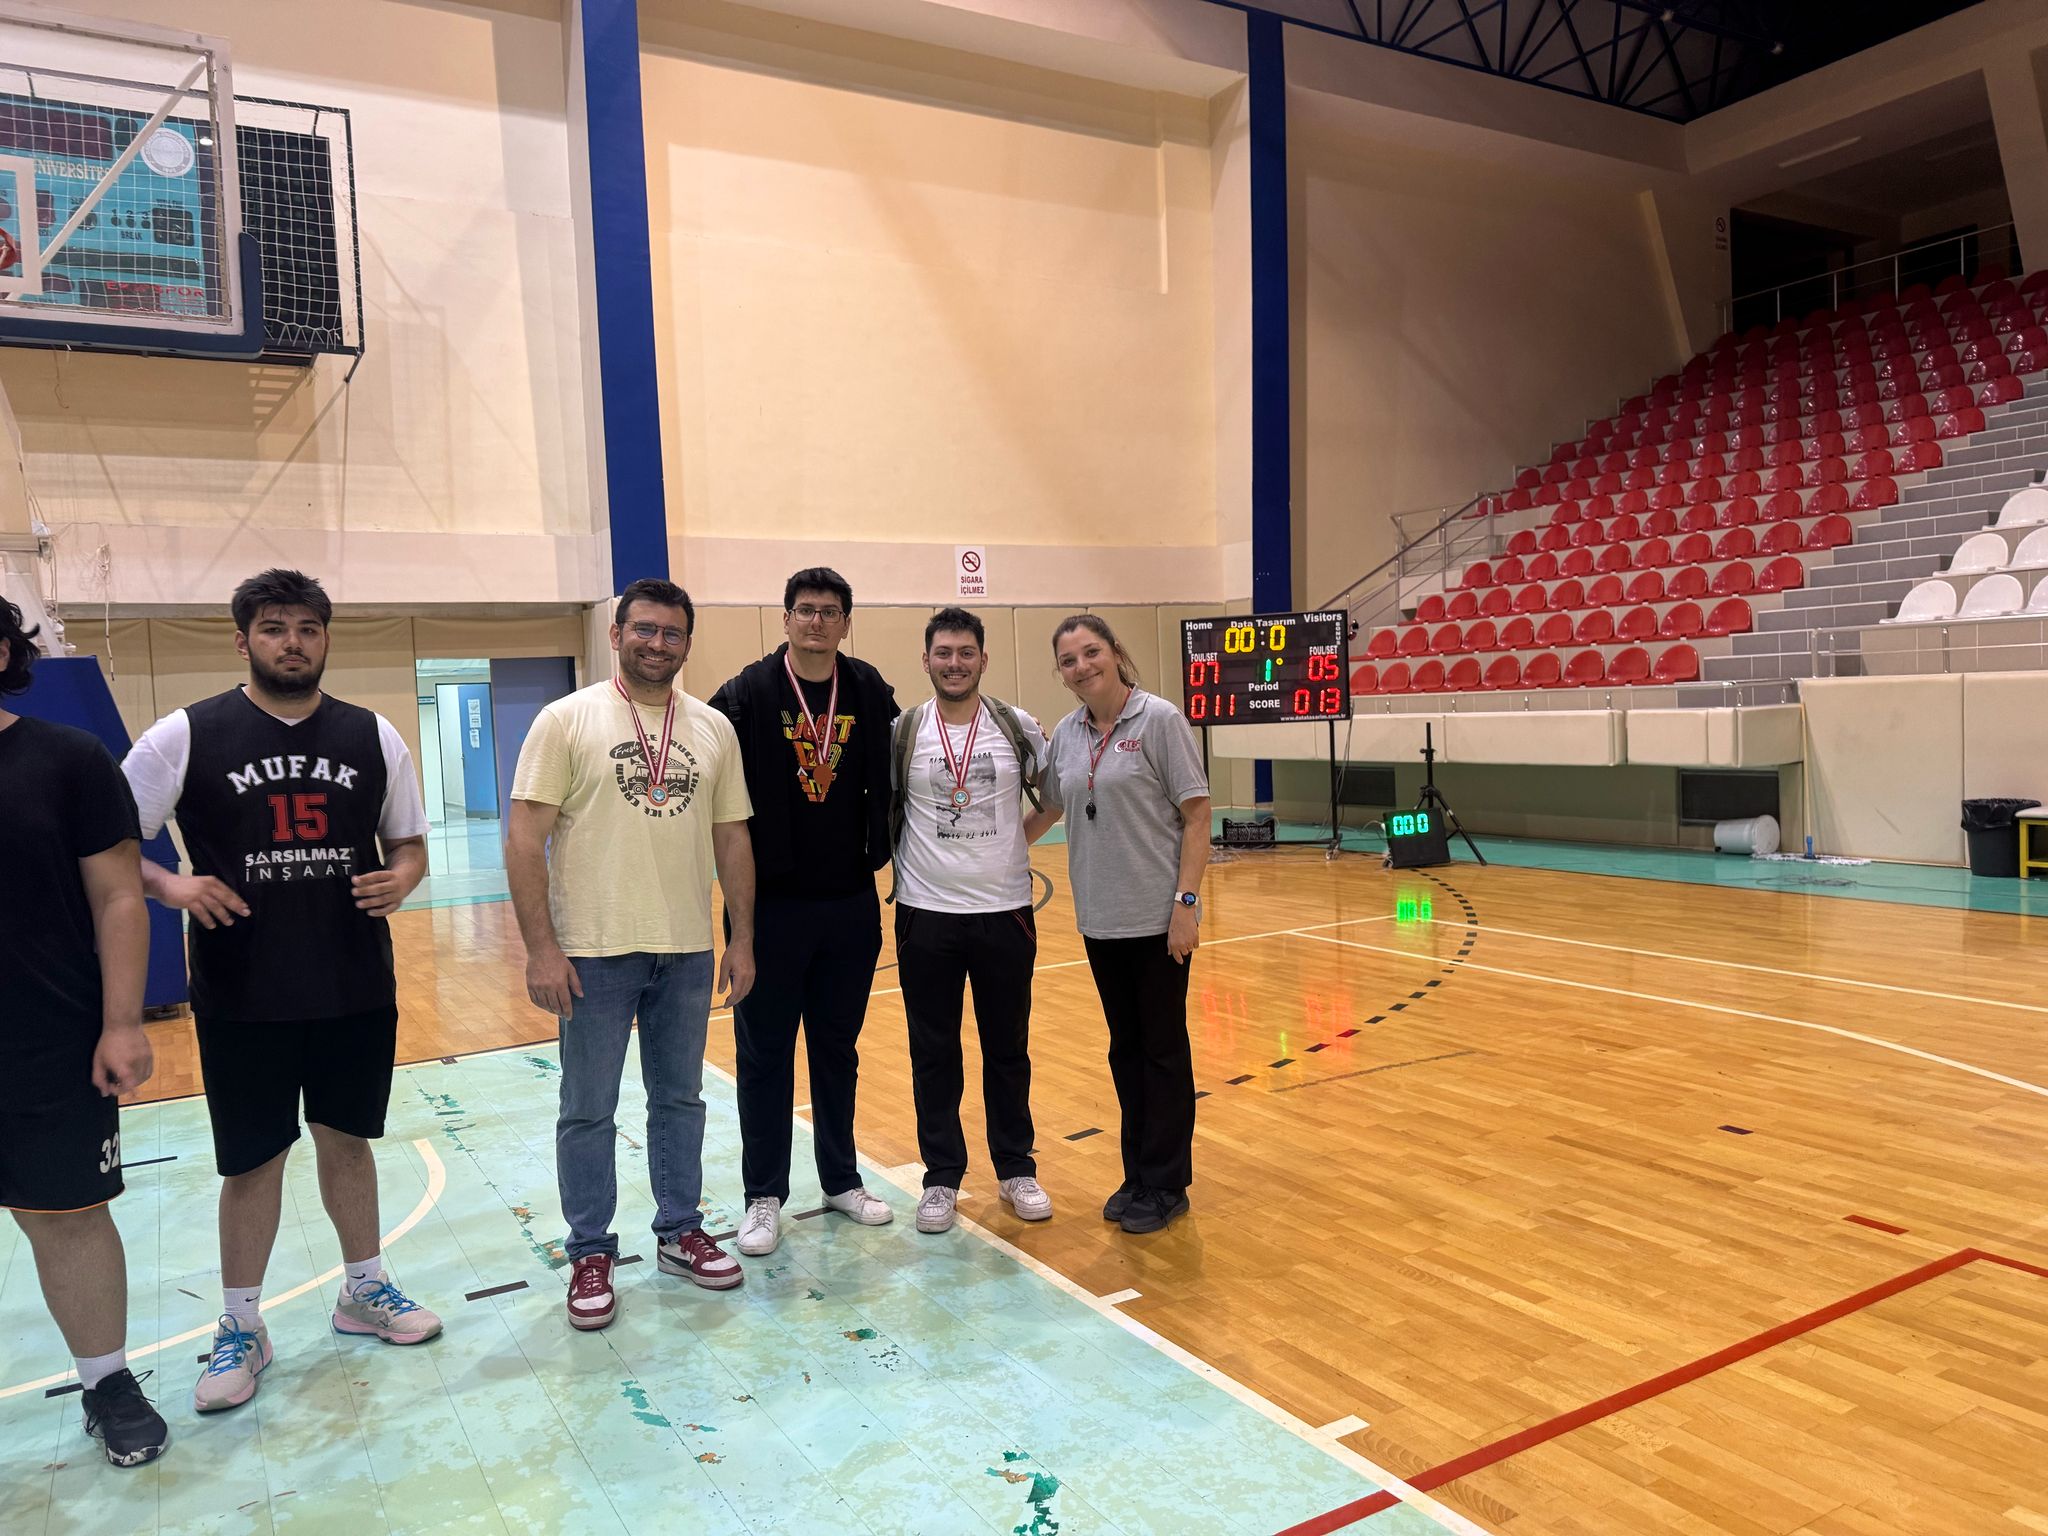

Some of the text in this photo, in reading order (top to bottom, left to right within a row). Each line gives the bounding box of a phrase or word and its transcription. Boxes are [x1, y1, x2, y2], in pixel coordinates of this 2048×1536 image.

[960, 585, 985, 595] İÇİLMEZ
[1186, 622, 1213, 631] Home
[1231, 618, 1296, 628] Data Tasarım
[1304, 613, 1342, 623] Visitors
[1190, 661, 1221, 686] 07
[1308, 655, 1339, 681] 05
[1248, 682, 1279, 692] Period
[1249, 699, 1280, 709] SCORE
[1294, 688, 1341, 715] 013
[613, 741, 641, 758] Fresh
[667, 738, 698, 766] RUCK
[226, 755, 358, 795] MUFAK
[267, 793, 329, 842] 15
[244, 848, 352, 867] SARSILMAZ
